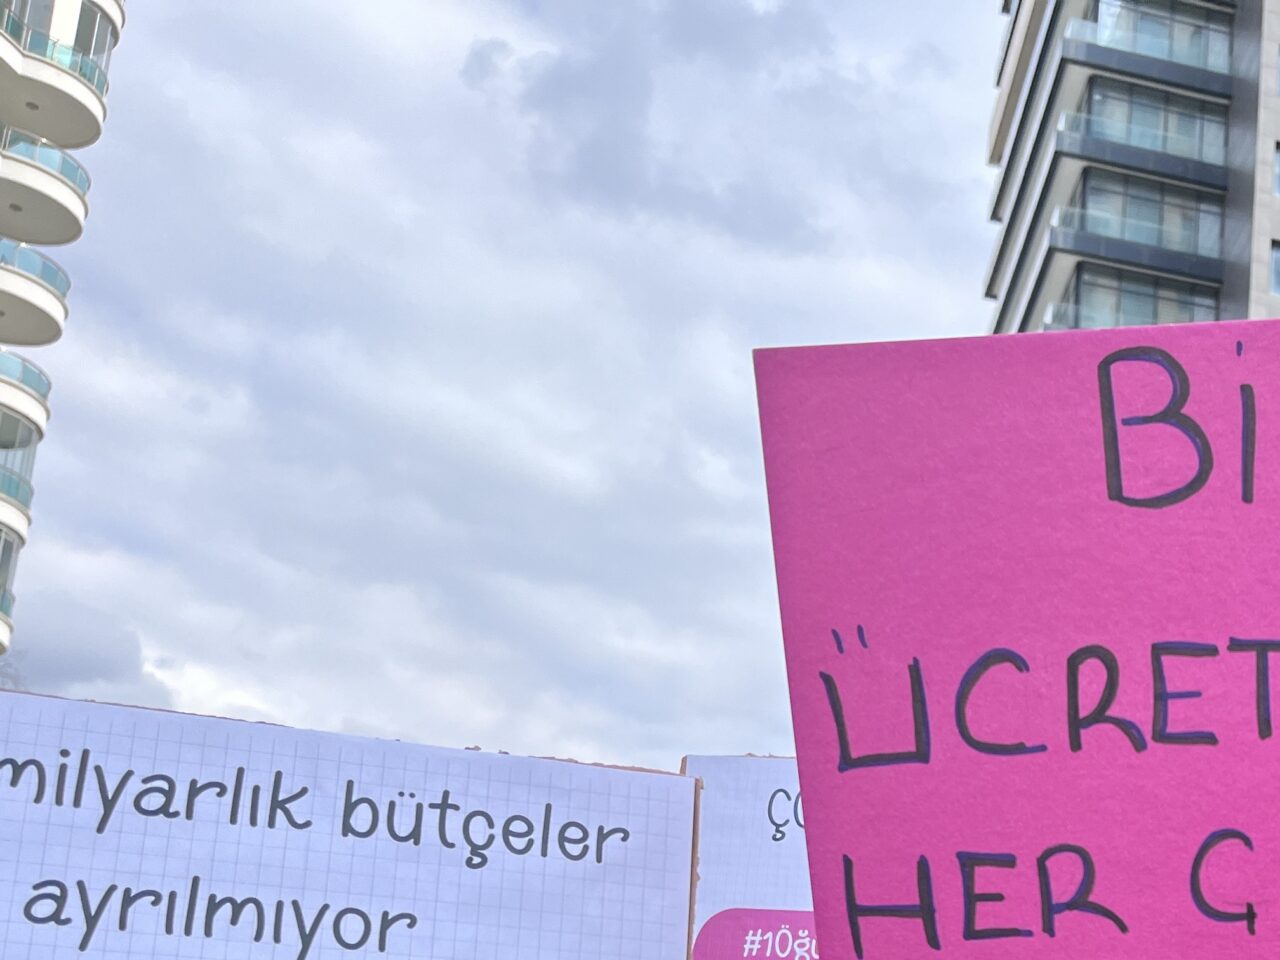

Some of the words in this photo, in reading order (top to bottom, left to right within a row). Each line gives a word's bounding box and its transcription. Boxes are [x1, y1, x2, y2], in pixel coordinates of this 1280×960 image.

[0, 748, 314, 835] milyarlık
[341, 778, 631, 870] bütçeler
[842, 843, 1129, 960] HER
